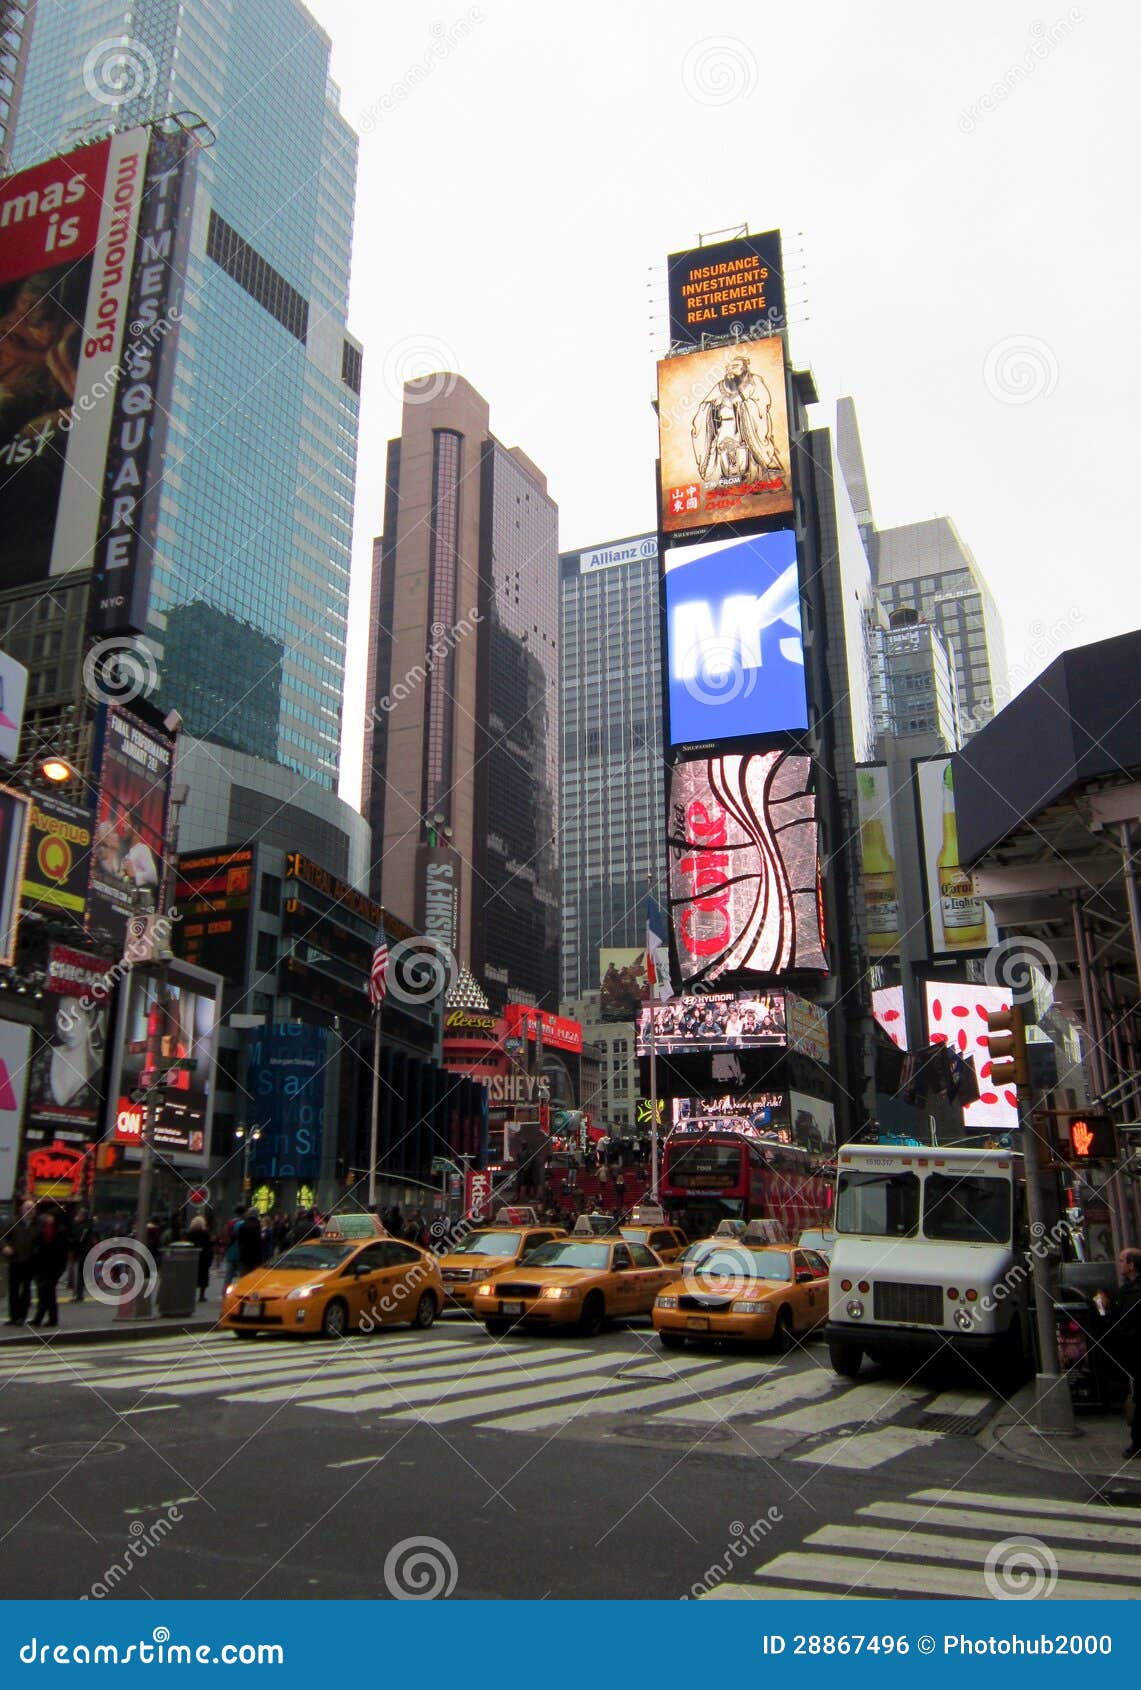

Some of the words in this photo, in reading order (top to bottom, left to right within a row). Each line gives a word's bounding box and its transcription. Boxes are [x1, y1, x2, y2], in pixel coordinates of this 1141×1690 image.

[44, 213, 81, 252] is
[84, 153, 139, 358] mormon.org
[138, 168, 179, 328] TIMES
[682, 267, 769, 296] INVESTMENTS
[689, 255, 760, 281] INSURANCE
[687, 282, 765, 309] RETIREMENT
[687, 307, 718, 323] REAL
[721, 296, 766, 316] ESTATE
[105, 347, 153, 570] SQUARE
[590, 547, 637, 567] Allianz
[100, 596, 125, 609] NYC
[30, 806, 91, 847] Avenue
[37, 833, 72, 885] Q
[680, 801, 731, 957] Coke
[698, 993, 735, 1003] HYUNDAI
[461, 1072, 551, 1102] RSHEY'S
